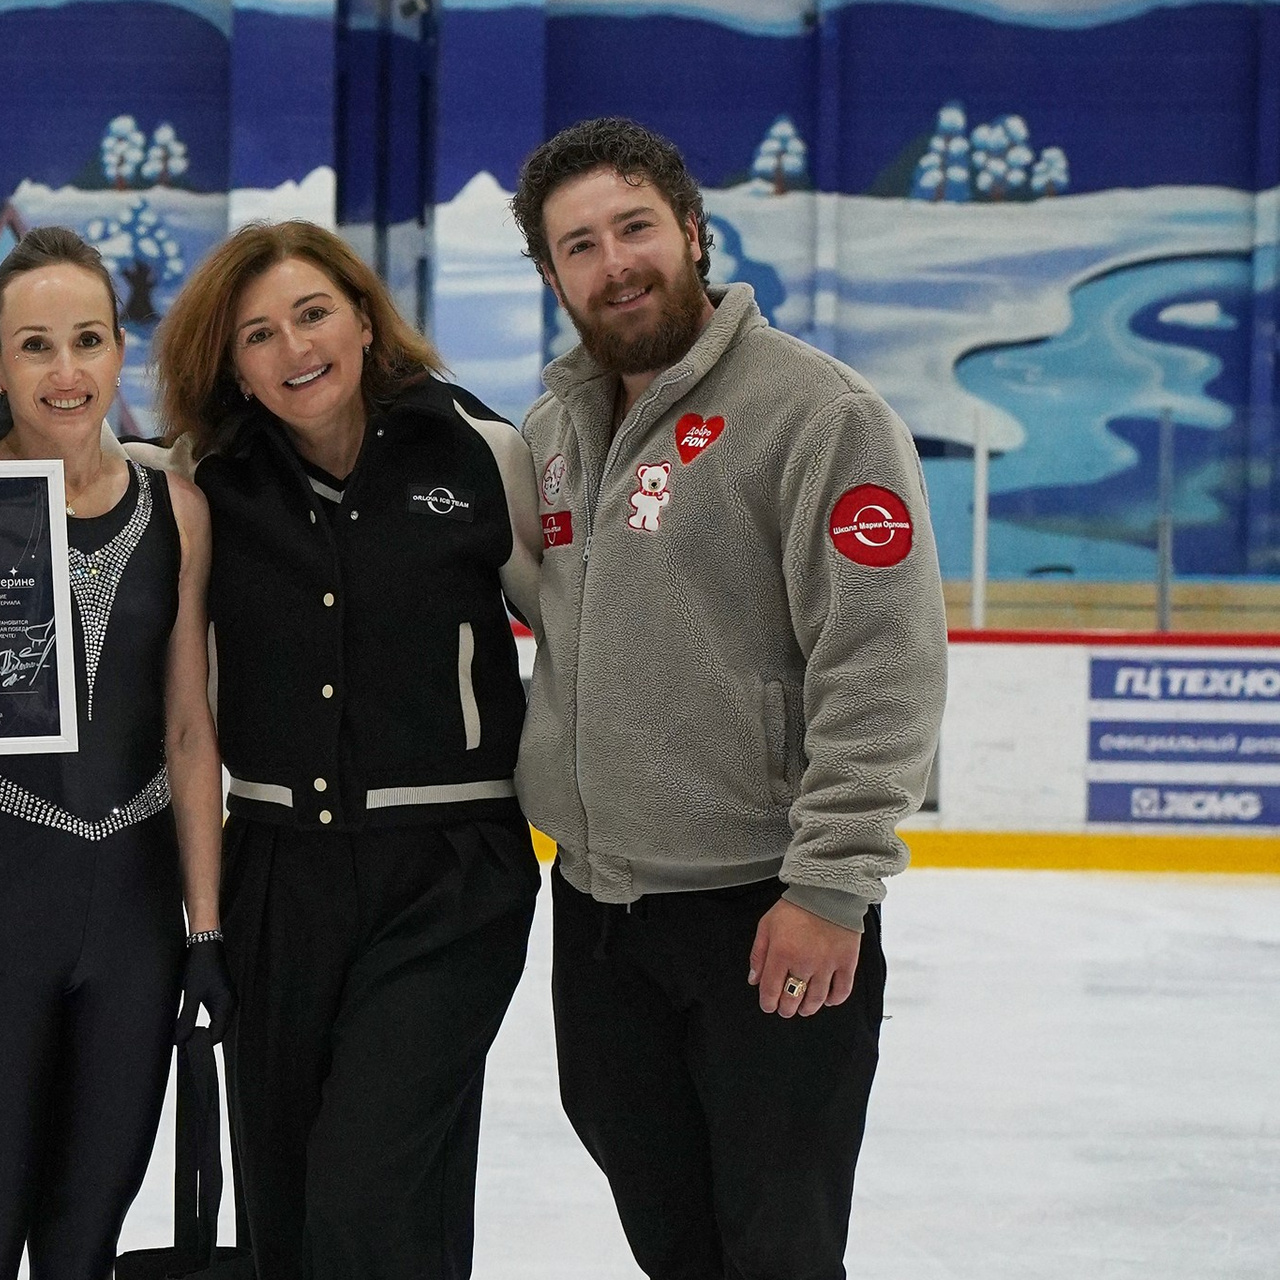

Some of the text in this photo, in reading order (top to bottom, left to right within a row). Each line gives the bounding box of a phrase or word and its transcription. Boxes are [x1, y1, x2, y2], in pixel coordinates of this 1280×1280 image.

[686, 424, 712, 437] Добро
[680, 436, 708, 447] FON
[439, 497, 451, 505] ICE
[451, 499, 469, 508] TEAM
[832, 520, 910, 535] Школа Марии Орловой
[1114, 667, 1280, 700] ГЦ ТЕХНО
